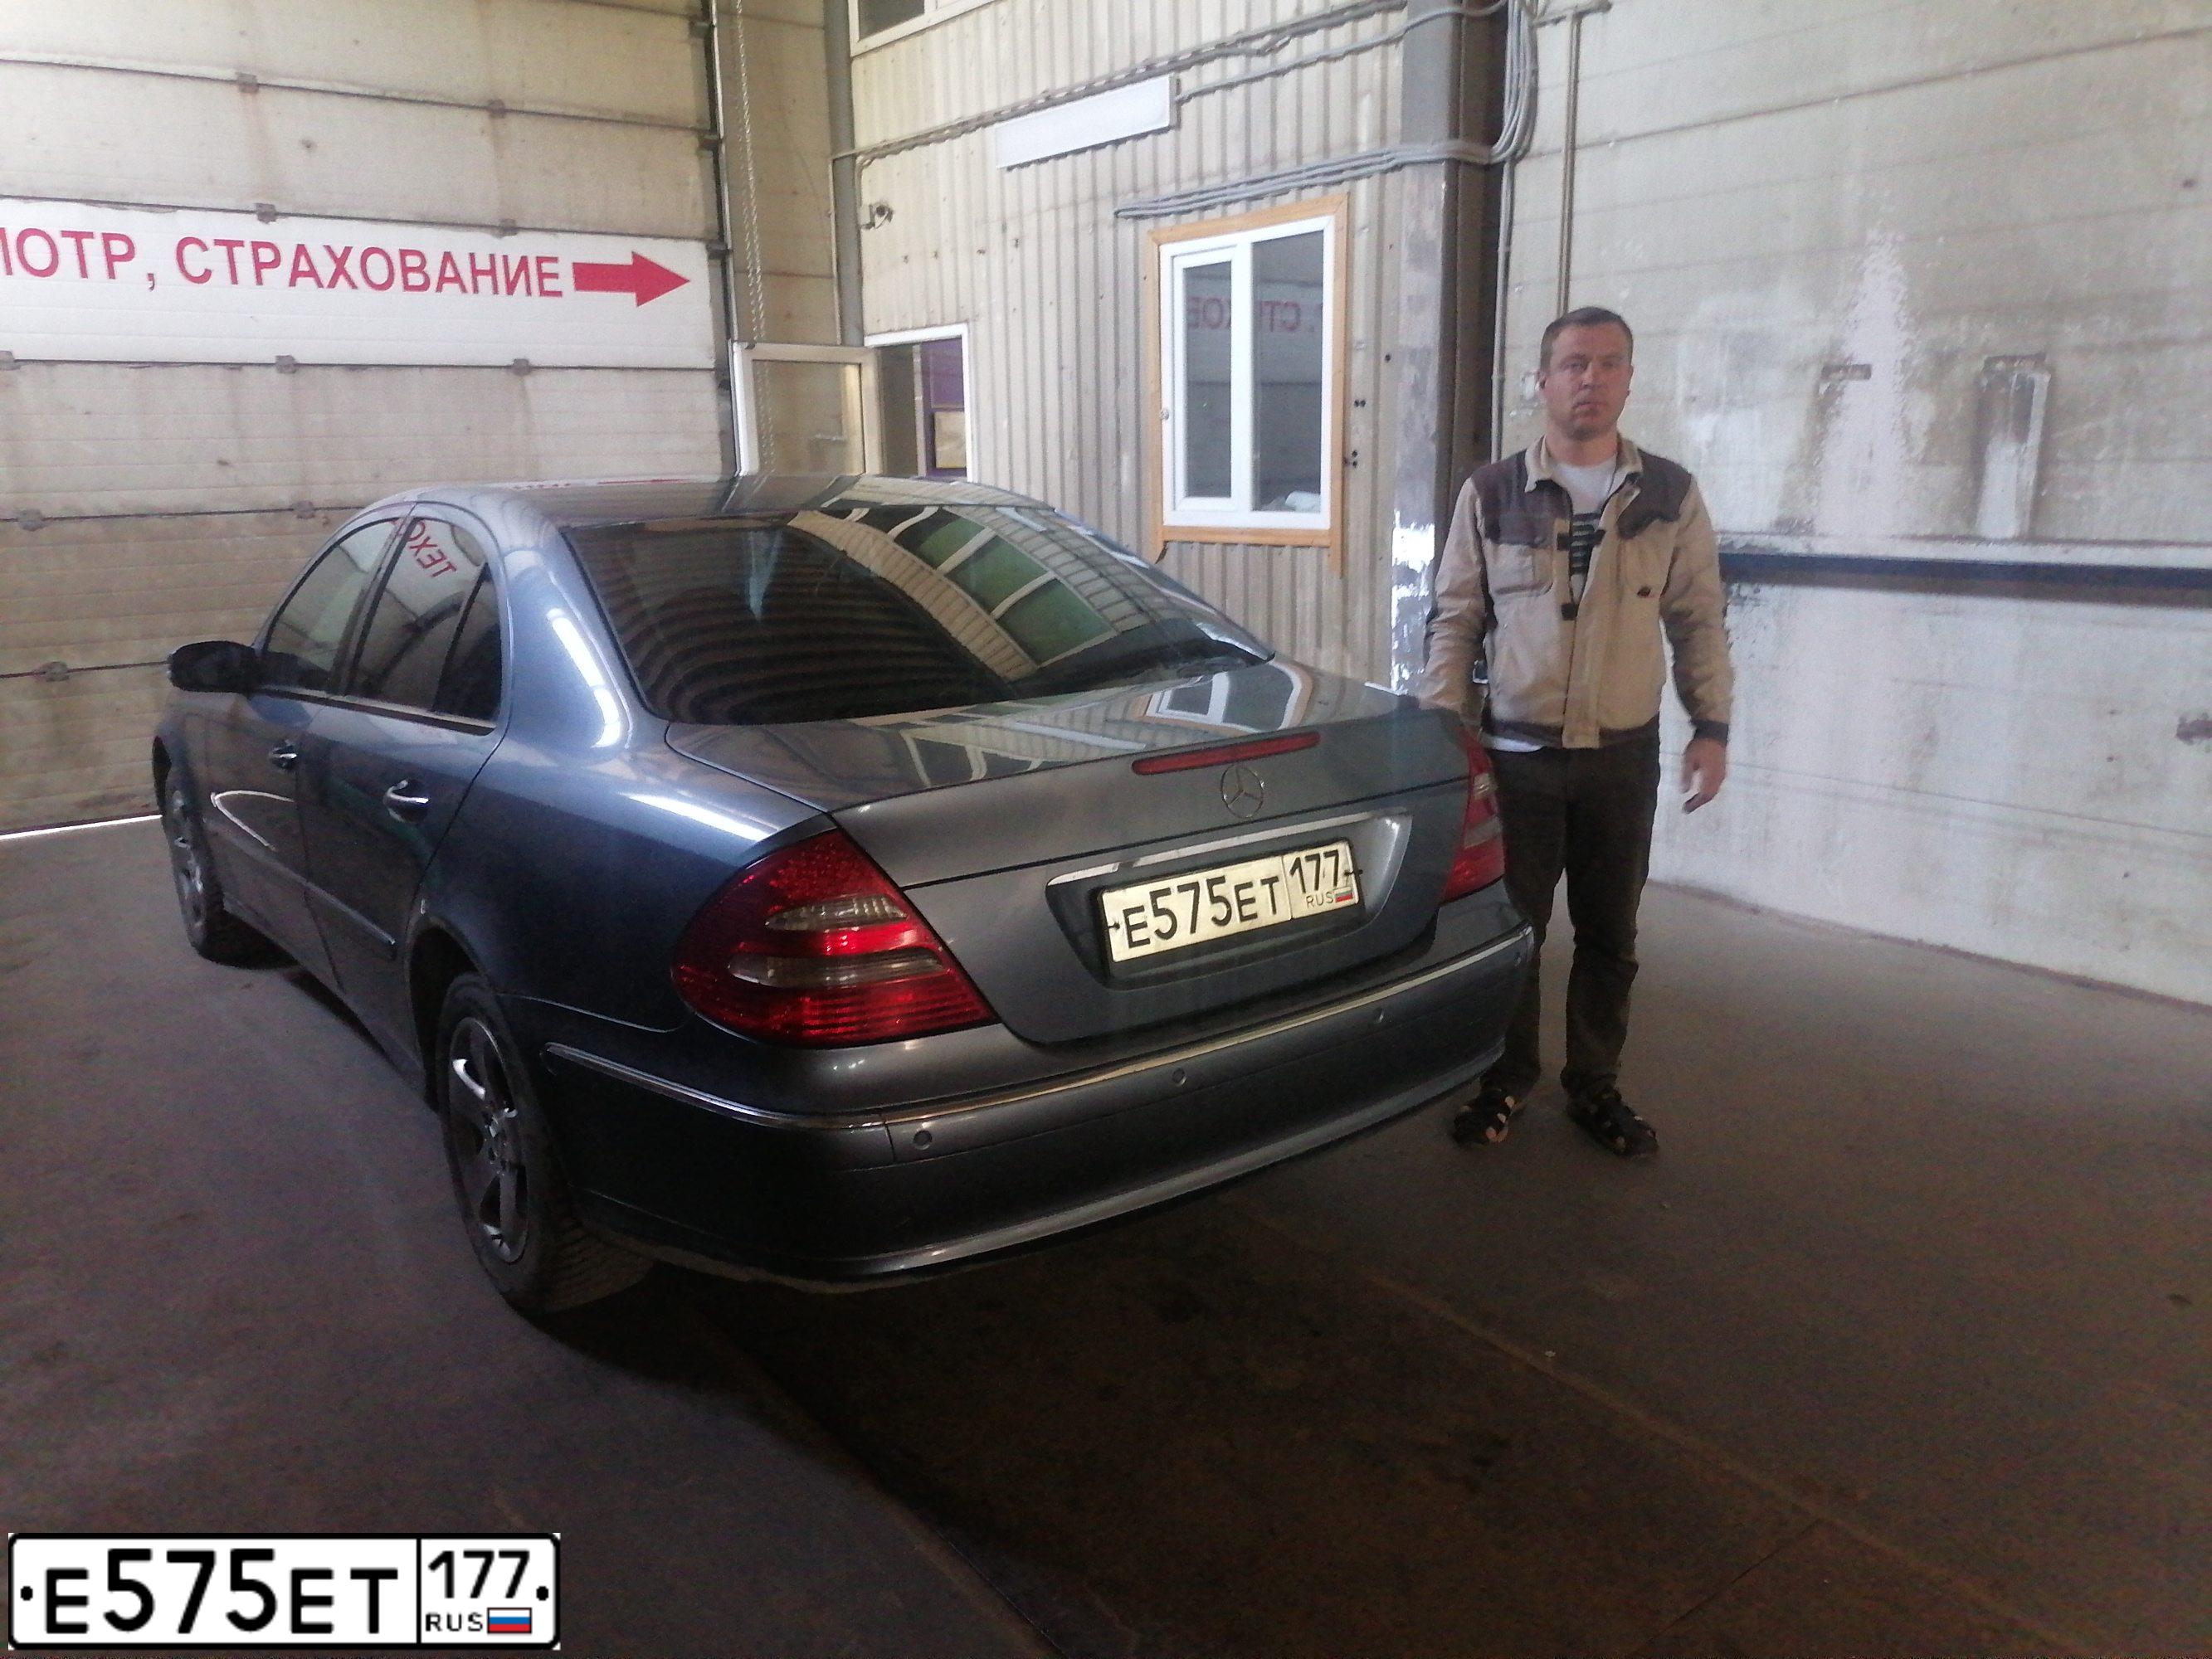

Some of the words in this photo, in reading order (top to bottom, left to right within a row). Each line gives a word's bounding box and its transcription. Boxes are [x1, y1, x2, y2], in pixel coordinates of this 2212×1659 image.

[175, 236, 563, 298] СТРАХОВАНИЕ
[1122, 875, 1280, 949] Е575ЕТ
[1289, 849, 1340, 893] 177
[1305, 892, 1334, 908] RUS
